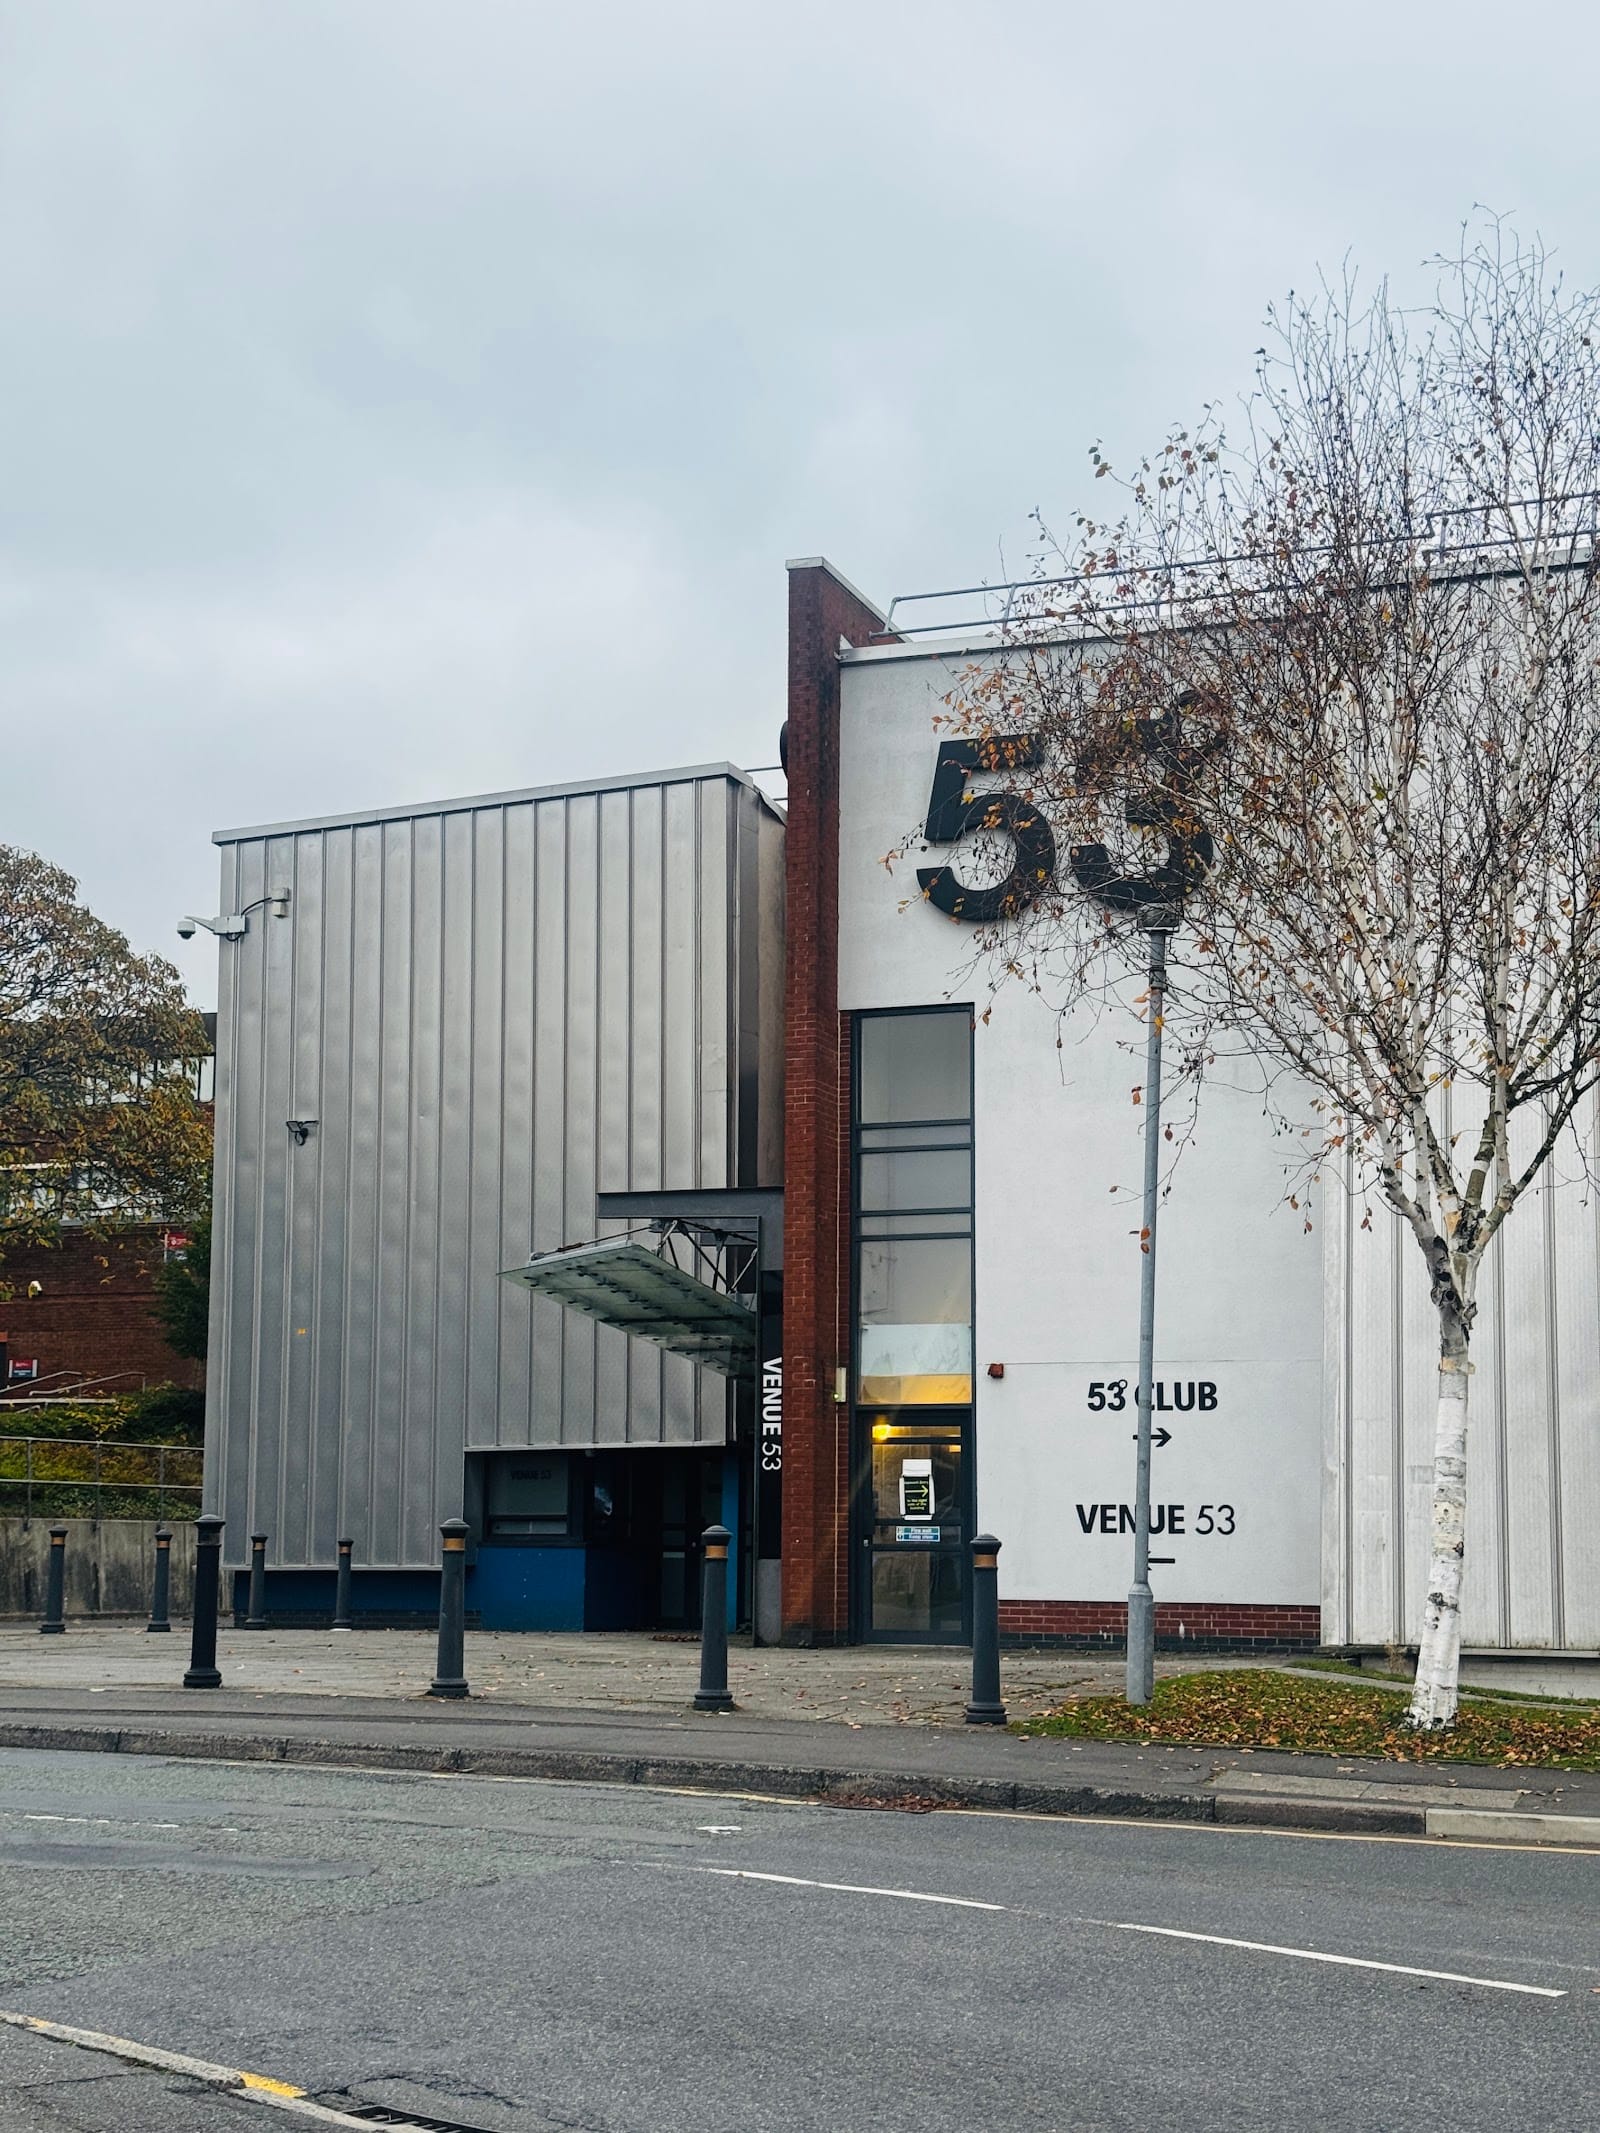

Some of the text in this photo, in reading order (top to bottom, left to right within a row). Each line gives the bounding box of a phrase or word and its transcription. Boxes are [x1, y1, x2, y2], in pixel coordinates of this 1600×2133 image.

[762, 1357, 782, 1470] VENUE 53
[1076, 1504, 1236, 1535] VENUE 53
